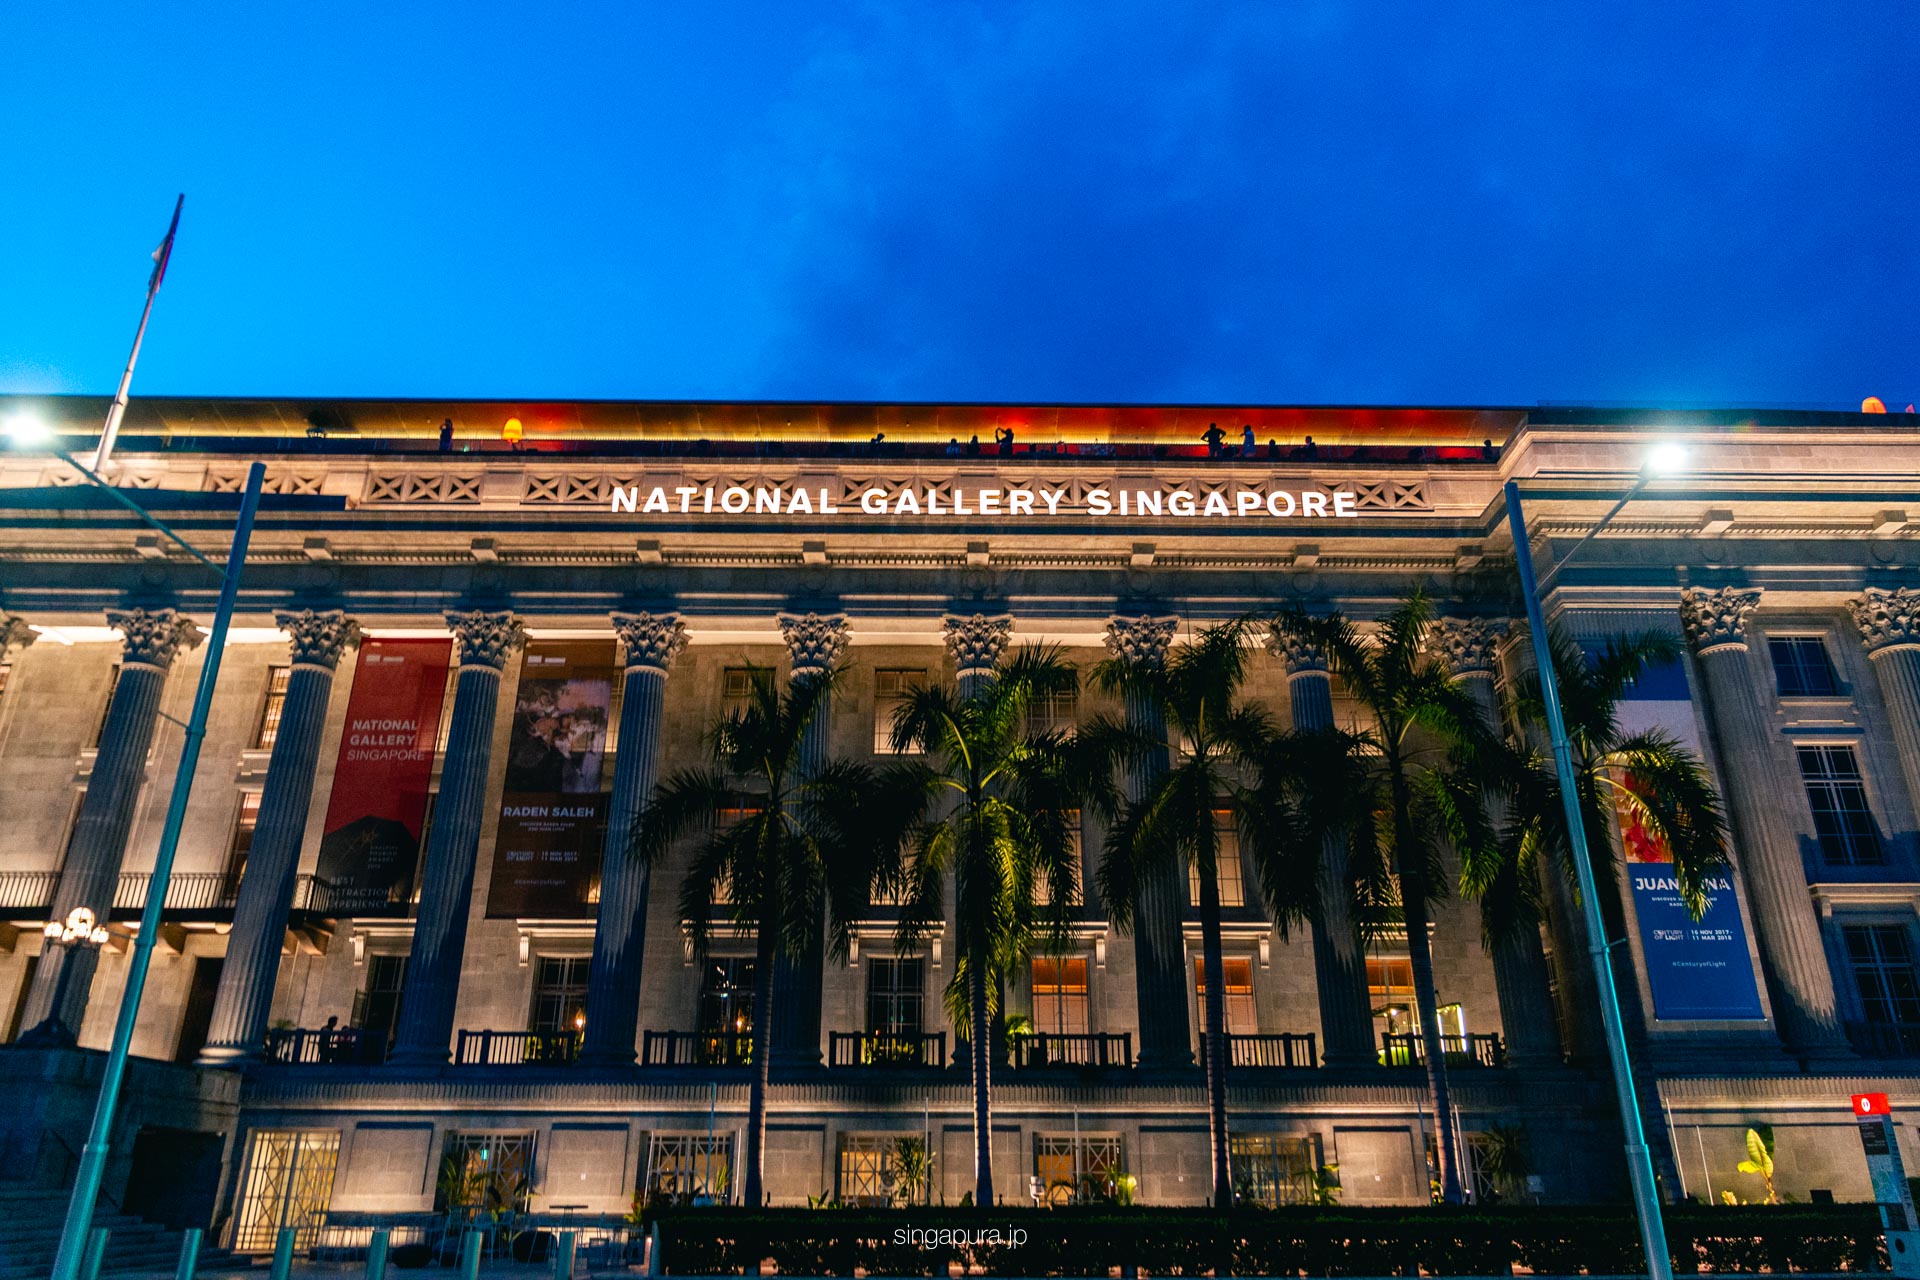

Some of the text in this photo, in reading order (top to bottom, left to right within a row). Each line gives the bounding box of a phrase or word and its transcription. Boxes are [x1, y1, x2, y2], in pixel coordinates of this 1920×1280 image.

[611, 486, 1359, 518] NATIONAL GALLERY SINGAPORE
[352, 719, 417, 731] NATIONAL
[349, 734, 416, 746] GALLERY
[346, 749, 425, 761] SINGAPORE
[503, 806, 595, 817] RADEN SALEH
[1635, 877, 1680, 890] JUAN
